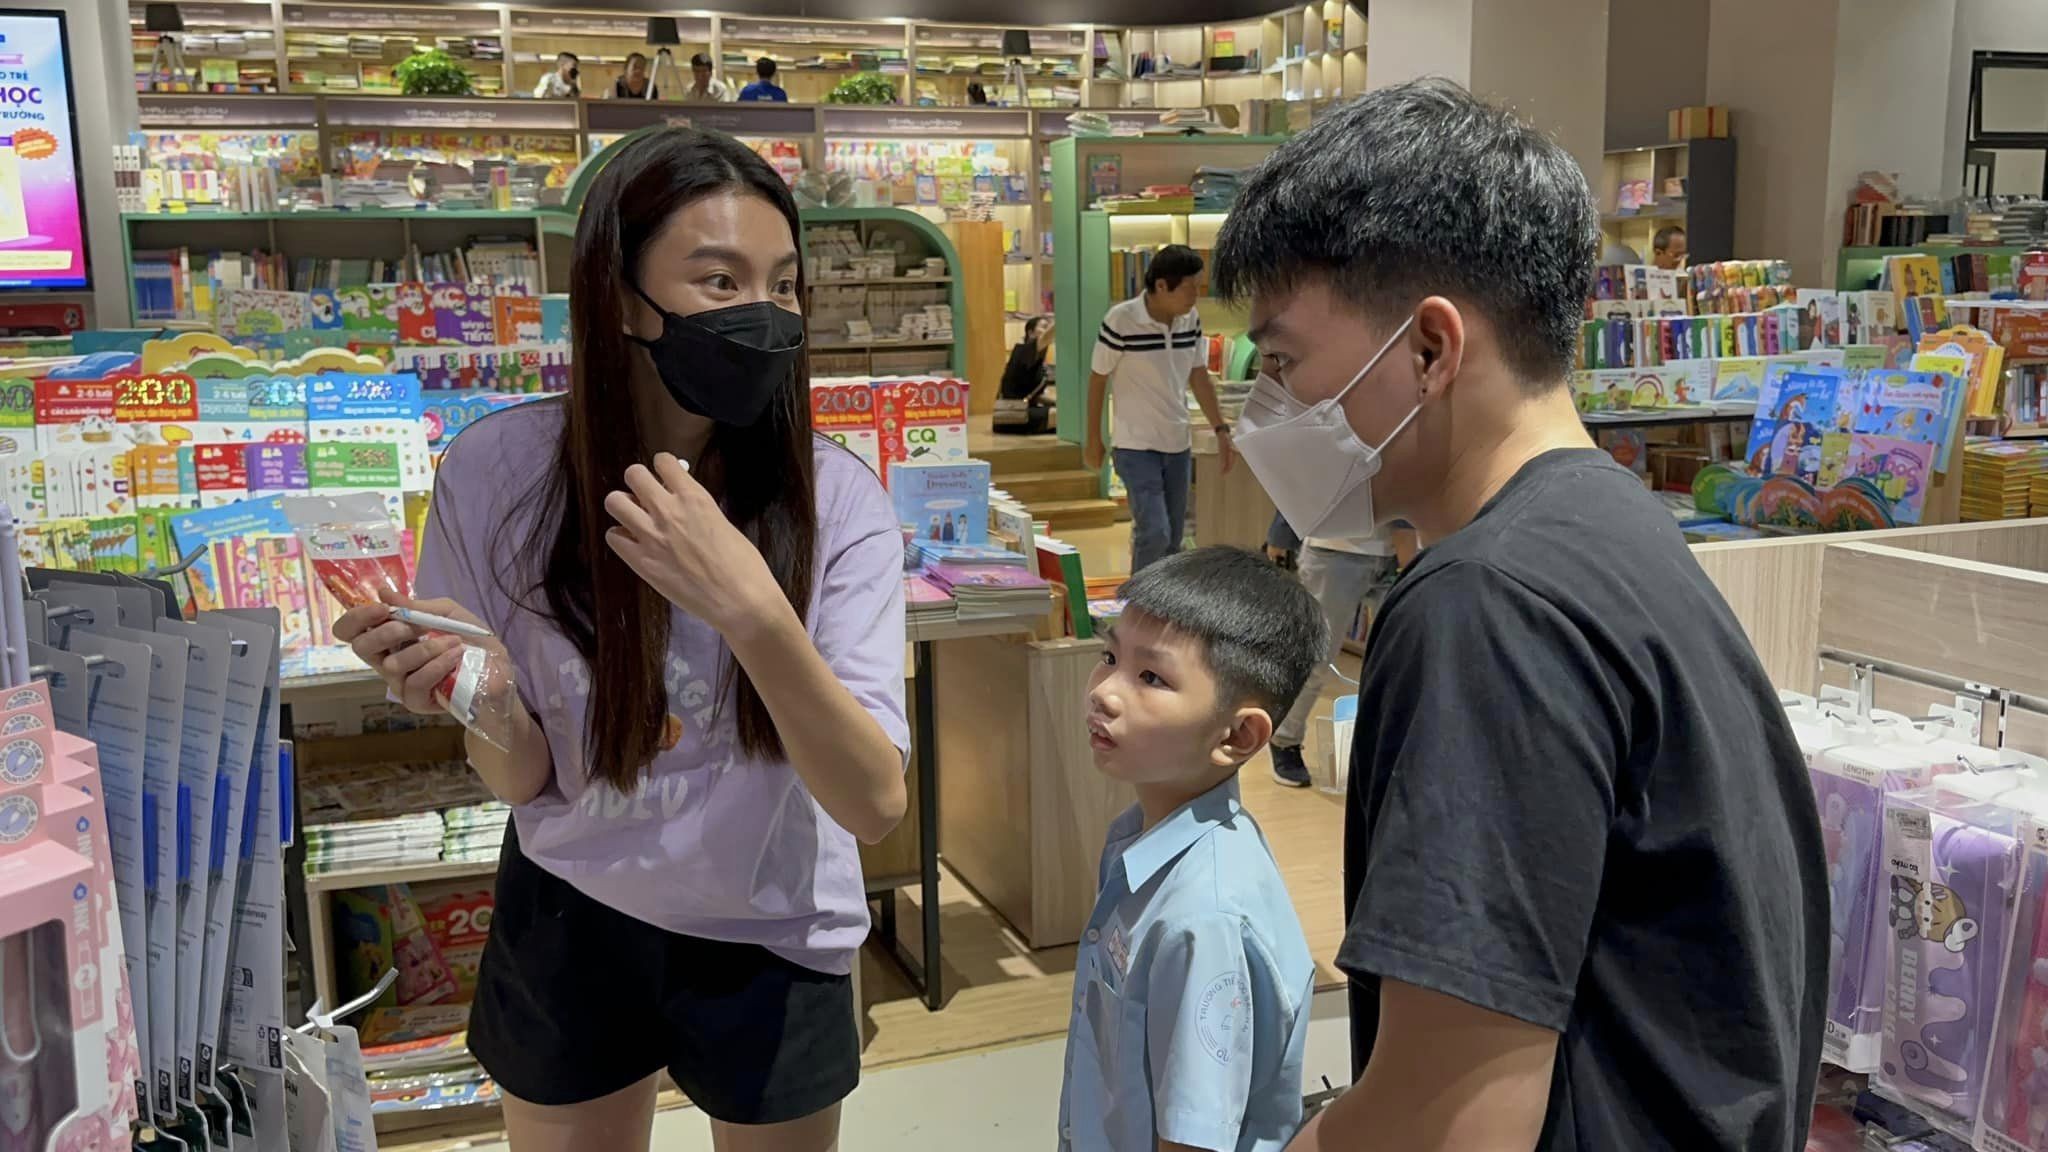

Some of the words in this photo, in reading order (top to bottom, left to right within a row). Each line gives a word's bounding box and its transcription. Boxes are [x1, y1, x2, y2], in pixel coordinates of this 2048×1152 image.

[116, 378, 192, 405] 200
[816, 390, 873, 413] 200
[905, 384, 962, 408] 200
[907, 427, 937, 443] CQ
